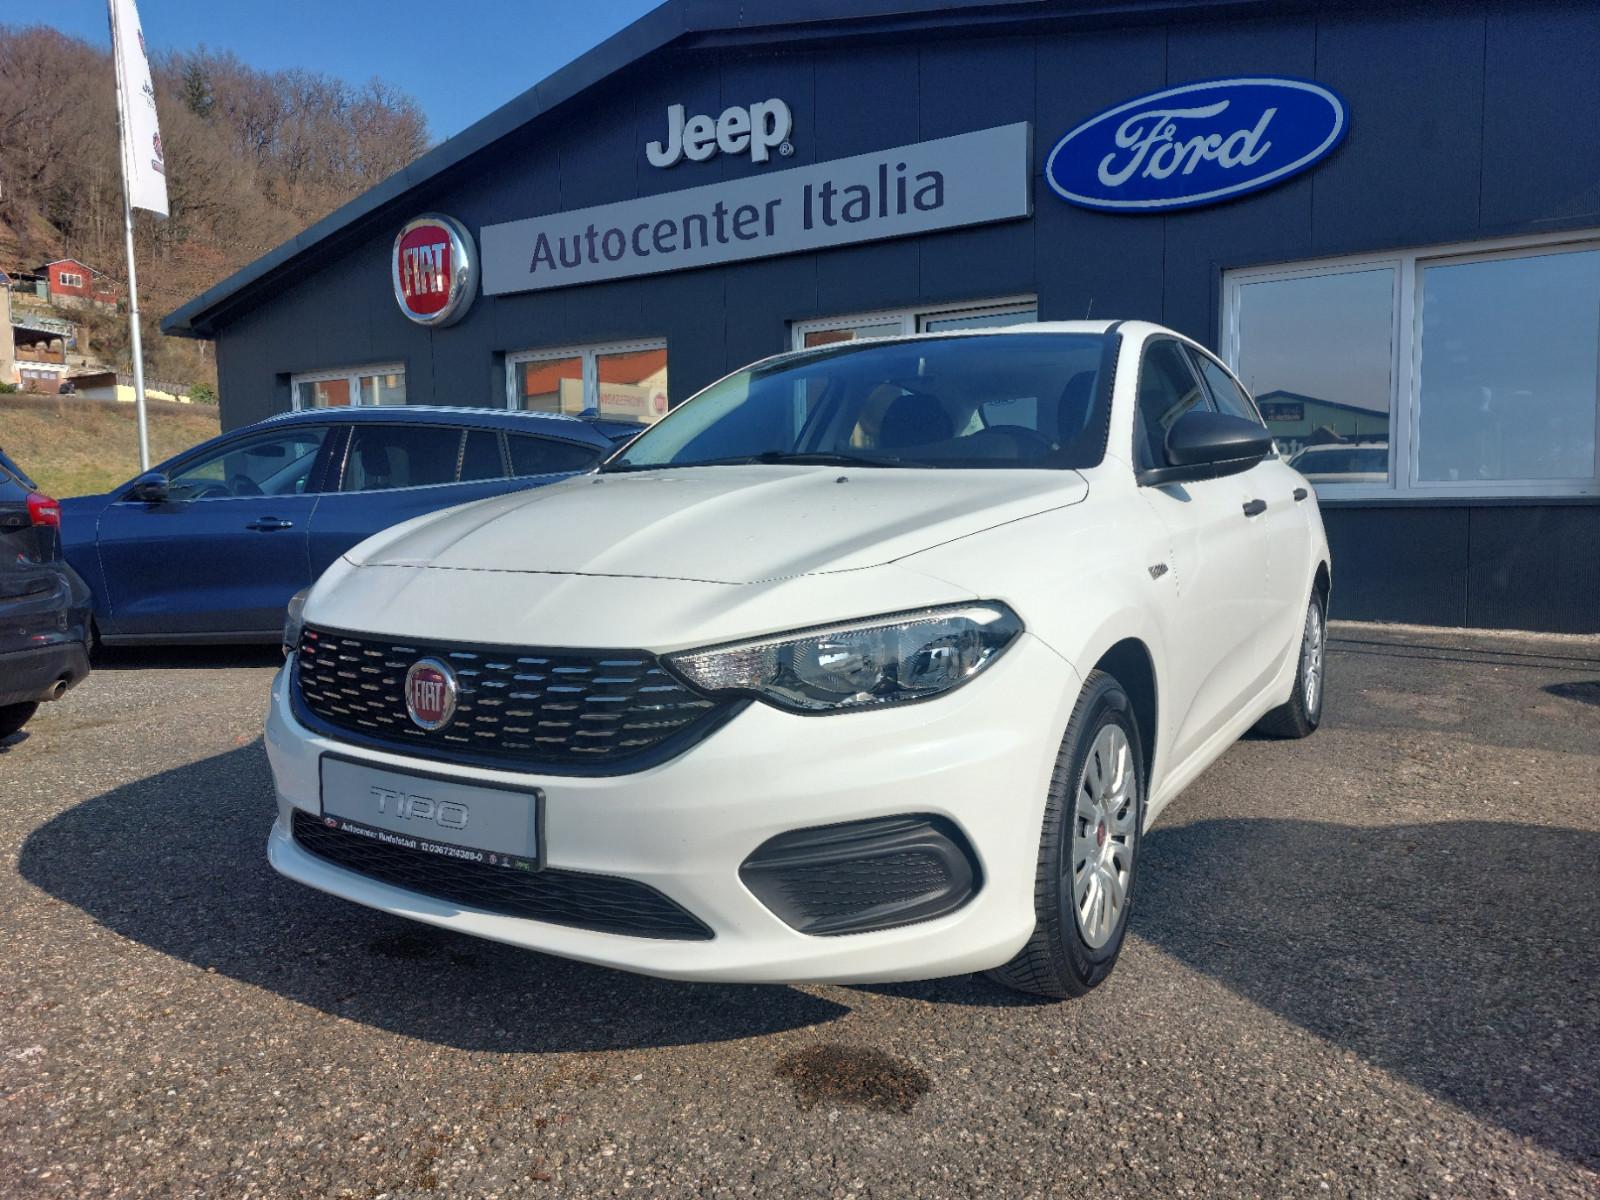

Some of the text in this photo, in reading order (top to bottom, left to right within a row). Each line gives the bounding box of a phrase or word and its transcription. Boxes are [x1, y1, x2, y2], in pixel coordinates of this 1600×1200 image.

[645, 98, 793, 168] Jeep
[1097, 99, 1278, 187] Ford
[529, 163, 945, 273] Autocenter Italia
[402, 242, 447, 297] FIAT
[414, 679, 444, 713] FIAT
[370, 786, 470, 831] TIPO
